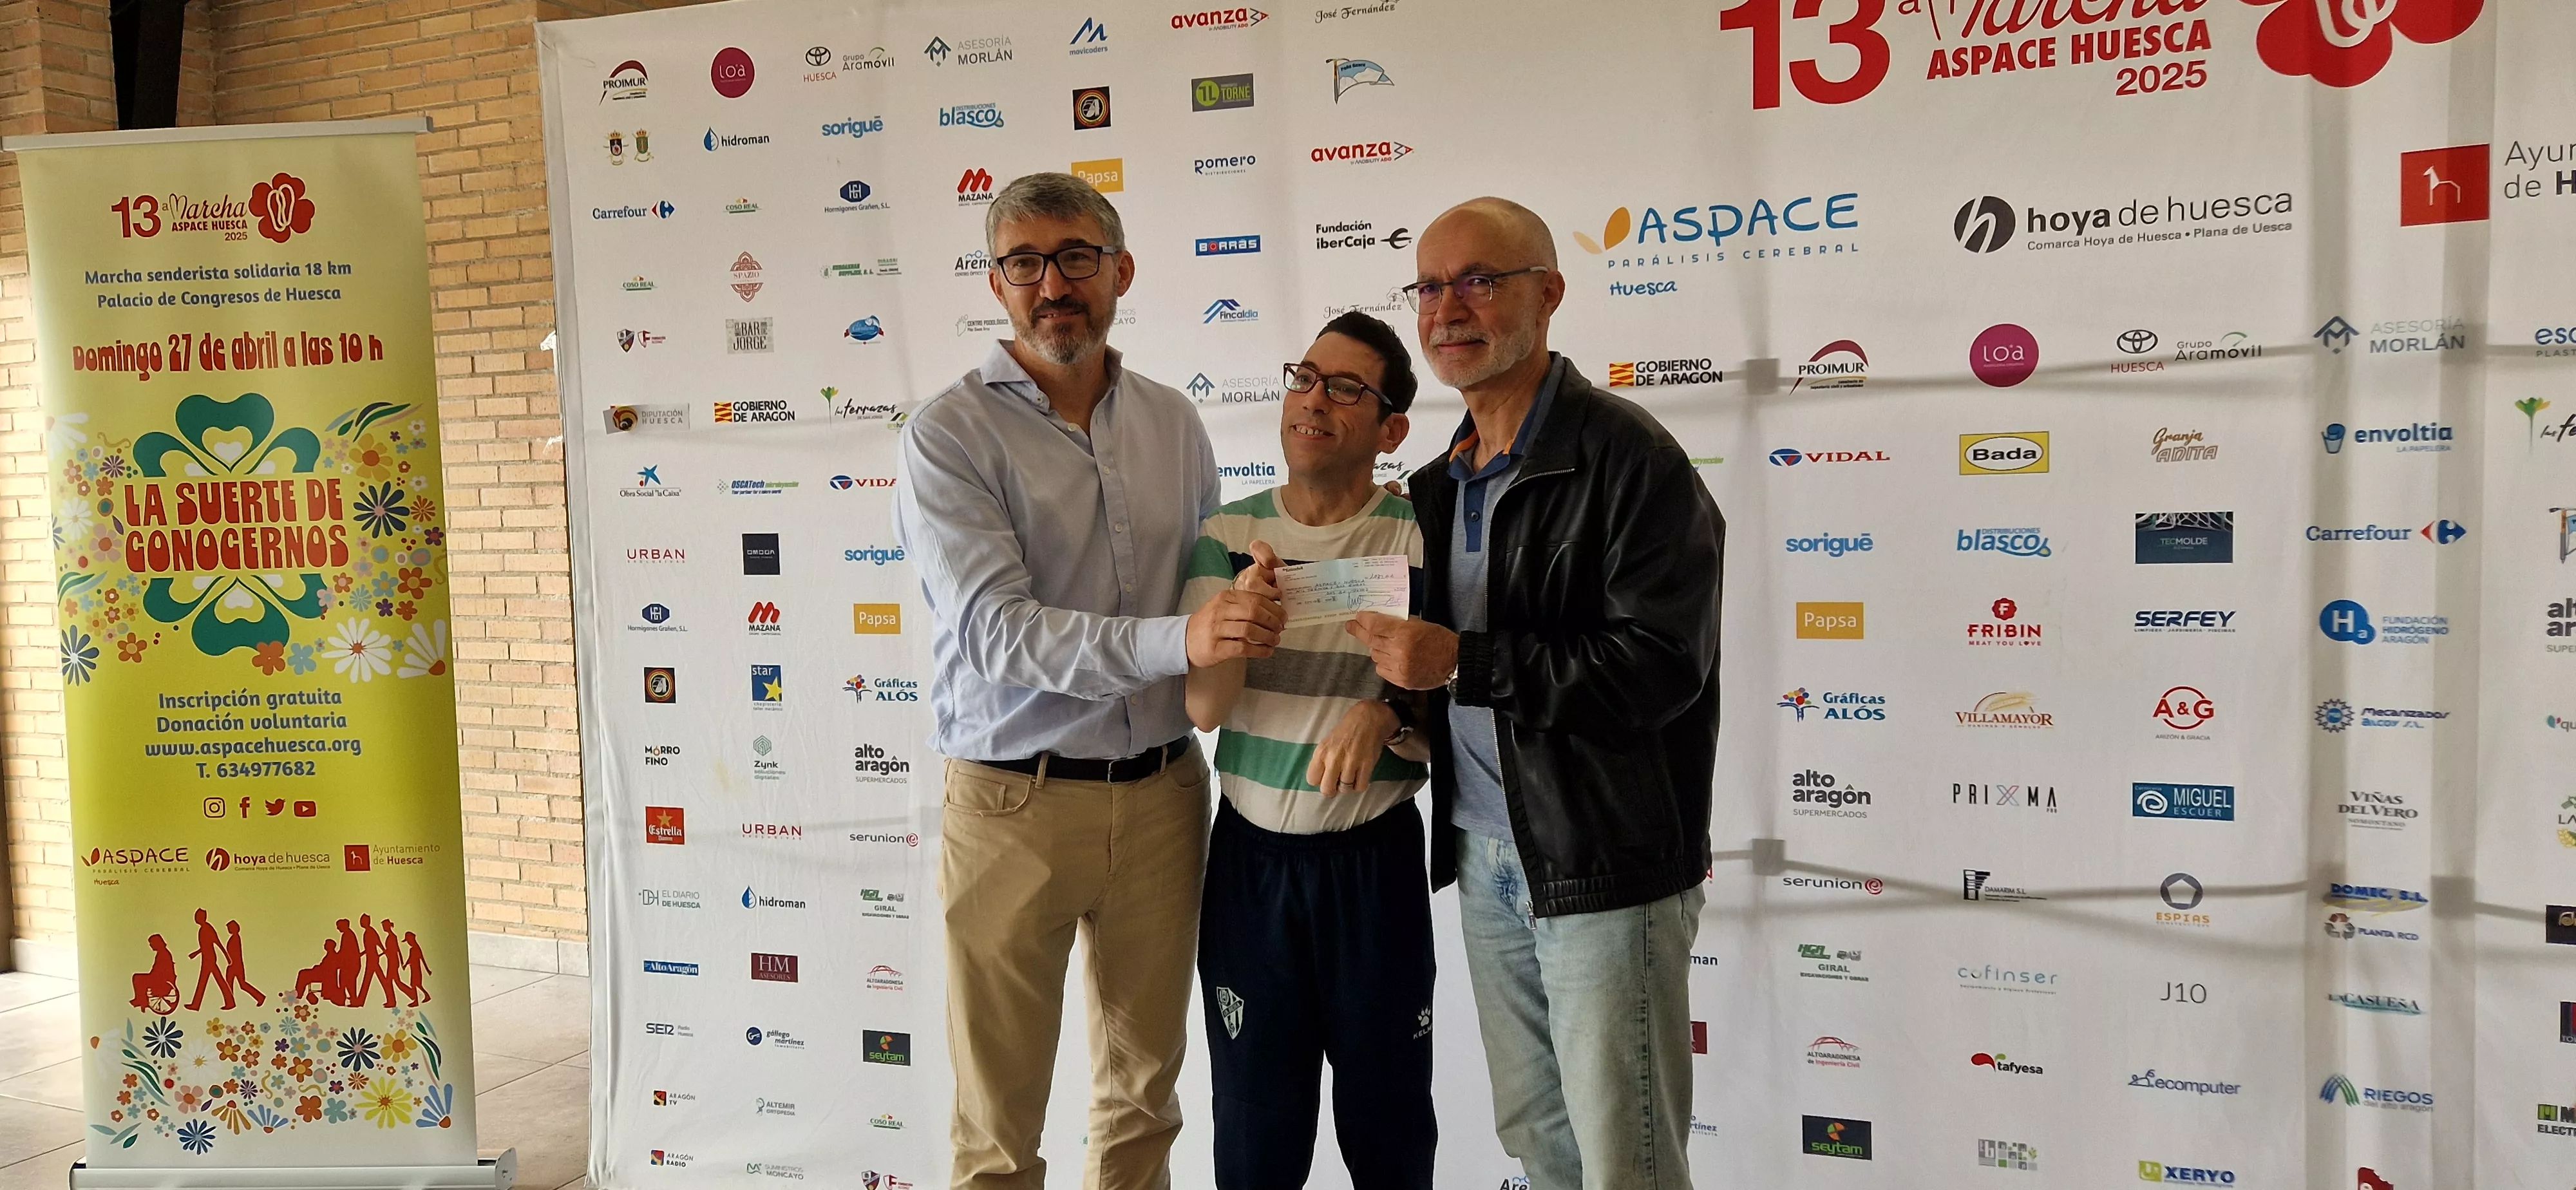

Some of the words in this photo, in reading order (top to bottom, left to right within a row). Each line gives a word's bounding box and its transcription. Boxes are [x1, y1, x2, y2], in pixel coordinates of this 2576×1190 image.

[1171, 8, 1248, 29] avanza
[1315, 9, 1337, 23] José
[1341, 3, 1395, 19] Fernández
[958, 35, 1012, 50] ASESORÍA
[958, 49, 1012, 65] MORLÁN
[1070, 45, 1108, 56] movicoders
[1926, 37, 2056, 80] ASPACE
[2070, 20, 2211, 64] HUESCA
[803, 71, 837, 82] HUESCA
[2116, 61, 2206, 96] 2025
[603, 78, 646, 90] PROIMUR
[940, 107, 996, 127] blasco
[721, 134, 770, 146] hidroman
[1311, 142, 1392, 162] avanza
[958, 193, 993, 202] MAZANA
[169, 193, 247, 220] Marcha
[592, 206, 647, 219] Carrefour
[1638, 193, 1858, 246] ASPACE
[2027, 207, 2110, 236] hoya
[2119, 200, 2159, 226] de
[2168, 192, 2293, 223] huesca
[171, 221, 208, 232] ASPACE
[211, 220, 247, 231] HUESCA
[1316, 220, 1372, 234] Fundación
[225, 232, 247, 241] 2025
[1317, 235, 1375, 249] iberCaja
[2027, 239, 2080, 250] Comarca
[2084, 236, 2115, 247] Hoya
[2119, 234, 2133, 244] de
[2137, 232, 2182, 242] Huesca
[2193, 227, 2228, 238] Plana
[2233, 225, 2248, 235] de
[2253, 221, 2292, 233] Uesca
[1609, 252, 1724, 268] PARÁLISIS
[1743, 243, 1859, 259] CEREBRAL
[85, 270, 142, 284] Marcha
[147, 267, 229, 281] senderista
[234, 264, 300, 279] solidaria
[305, 263, 321, 276] 18
[328, 261, 352, 276] km
[734, 271, 760, 279] SPAZIO
[1610, 280, 1678, 295] Huesca
[98, 294, 153, 308] Palacio
[158, 293, 176, 305] de
[181, 291, 260, 307] Congresos
[264, 289, 281, 302] de
[286, 287, 341, 301] Huesca
[2371, 318, 2465, 334] ASESORÍA
[734, 336, 767, 351] JORGE
[2177, 340, 2212, 348] Grupo
[2370, 335, 2465, 354] MORLÁN
[73, 340, 162, 381] Domingo
[169, 334, 191, 371] 27
[199, 333, 226, 370] de
[232, 331, 278, 371] abril
[283, 338, 296, 366] a
[301, 331, 334, 365] las
[339, 334, 363, 363] 10
[370, 335, 383, 361] h
[1636, 358, 1712, 372] GOBIERNO
[1798, 363, 1864, 375] PROIMUR
[2111, 361, 2164, 373] HUESCA
[1222, 374, 1279, 387] ASESORÍA
[1636, 374, 1654, 386] DE
[1660, 371, 1723, 384] ARAGON
[1222, 388, 1280, 403] MORLÁN
[734, 401, 787, 411] GOBIERNO
[734, 412, 748, 421] DE
[752, 411, 795, 421] ARAGON
[2354, 422, 2452, 443] envoltia
[2152, 428, 2204, 455] Granja
[1806, 451, 1890, 462] VIDAL
[1973, 447, 2037, 460] Bada
[124, 484, 167, 526] LA
[175, 480, 297, 525] SUERTE
[306, 478, 343, 521] DE
[1956, 529, 2040, 552] blasco
[2306, 525, 2412, 542] Carrefour
[126, 525, 349, 572] CONOCERNOS
[2160, 537, 2208, 546] TECMOLDE
[627, 549, 685, 559] URBAN
[859, 612, 896, 628] Papsa
[1804, 612, 1857, 631] Papsa
[2135, 610, 2236, 627] SERFEY
[2383, 616, 2448, 625] FUNDACIÓN
[1967, 624, 2041, 638] FRIBIN
[2383, 626, 2449, 635] HIDRÓGENO
[2382, 635, 2429, 644] ARAGÓN
[752, 666, 773, 676] star
[874, 677, 918, 689] Gráficas
[158, 688, 260, 712] Inscripción
[267, 688, 342, 710] gratuita
[875, 689, 918, 702] ALÓS
[1823, 692, 1886, 704] Gráficas
[1824, 705, 1886, 720] ALÓS
[1955, 712, 2054, 726] VILLAMAYOR
[156, 712, 244, 733] Donación
[251, 712, 346, 730] voluntaria
[145, 737, 361, 758] www.aspacehuesca.org
[855, 743, 885, 759] alto
[645, 757, 668, 766] FINO
[754, 760, 778, 770] Zynk
[196, 762, 210, 778] T.
[216, 760, 316, 778] 634977682
[1792, 769, 1835, 788] alto
[2174, 787, 2231, 808] MIGUEL
[2350, 791, 2403, 804] VIÑAS
[1793, 809, 1867, 818] SUPERMERCADOS
[2174, 807, 2221, 817] ESCUER
[649, 824, 683, 836] Estrella
[742, 824, 802, 836] URBAN
[849, 833, 904, 844] serunion
[102, 847, 189, 864] ASPACE
[373, 843, 440, 854] Ayuntamiento
[233, 853, 266, 866] hoya
[268, 853, 284, 863] de
[285, 851, 330, 864] huesca
[387, 855, 422, 864] Huesca
[94, 877, 119, 886] Huesca
[1783, 876, 1862, 890] serunion
[662, 890, 670, 898] EL
[672, 891, 699, 900] DIARIO
[759, 895, 806, 909] hidroman
[2156, 912, 2210, 923] ESPIAS
[759, 956, 790, 973] HM
[1818, 963, 1850, 973] GIRAL
[1958, 965, 2058, 985] cofinser
[2161, 981, 2207, 1003] J10
[775, 1037, 804, 1046] martínez
[869, 1051, 904, 1062] seytam
[1997, 1061, 2043, 1075] tafyesa
[2155, 1079, 2242, 1095] ecomputer
[2363, 1088, 2433, 1105] RIEGOS
[766, 1100, 795, 1110] ALTEMIR
[870, 1117, 887, 1126] COSO
[1811, 1142, 1862, 1156] seytam
[667, 1153, 694, 1161] ARAGÓN
[766, 1171, 804, 1180] MONCAYO
[2164, 1166, 2235, 1184] XERYO
